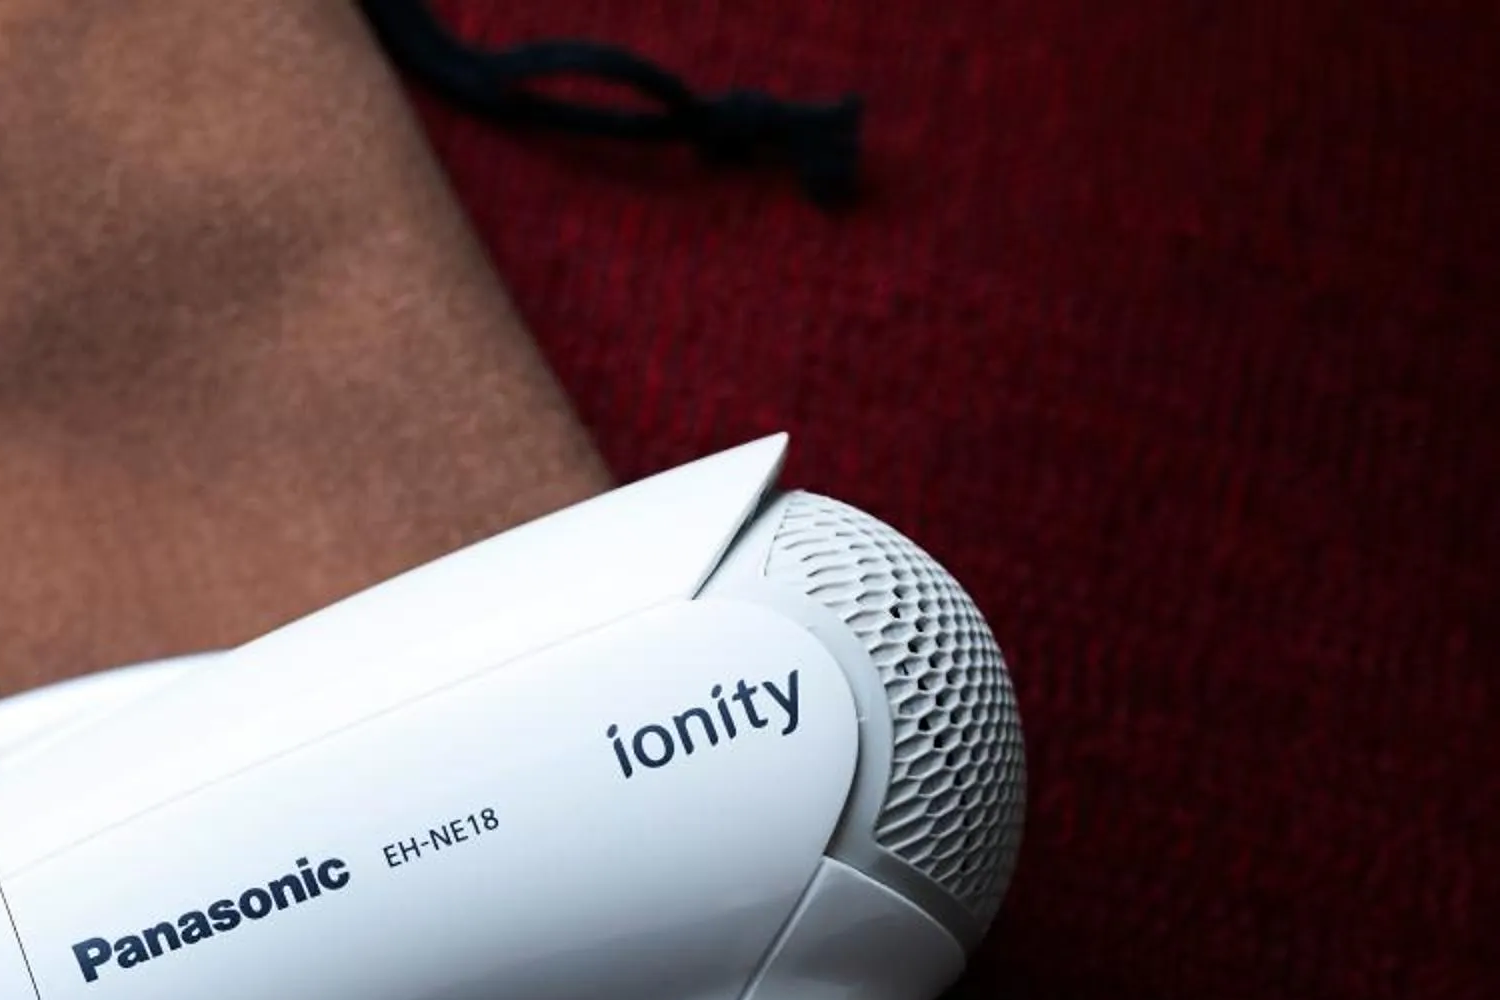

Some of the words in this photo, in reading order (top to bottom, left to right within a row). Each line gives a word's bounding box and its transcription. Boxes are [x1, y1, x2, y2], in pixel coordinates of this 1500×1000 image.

[606, 669, 799, 778] ionity
[72, 856, 351, 983] Panasonic
[382, 806, 500, 868] EH-NE18
